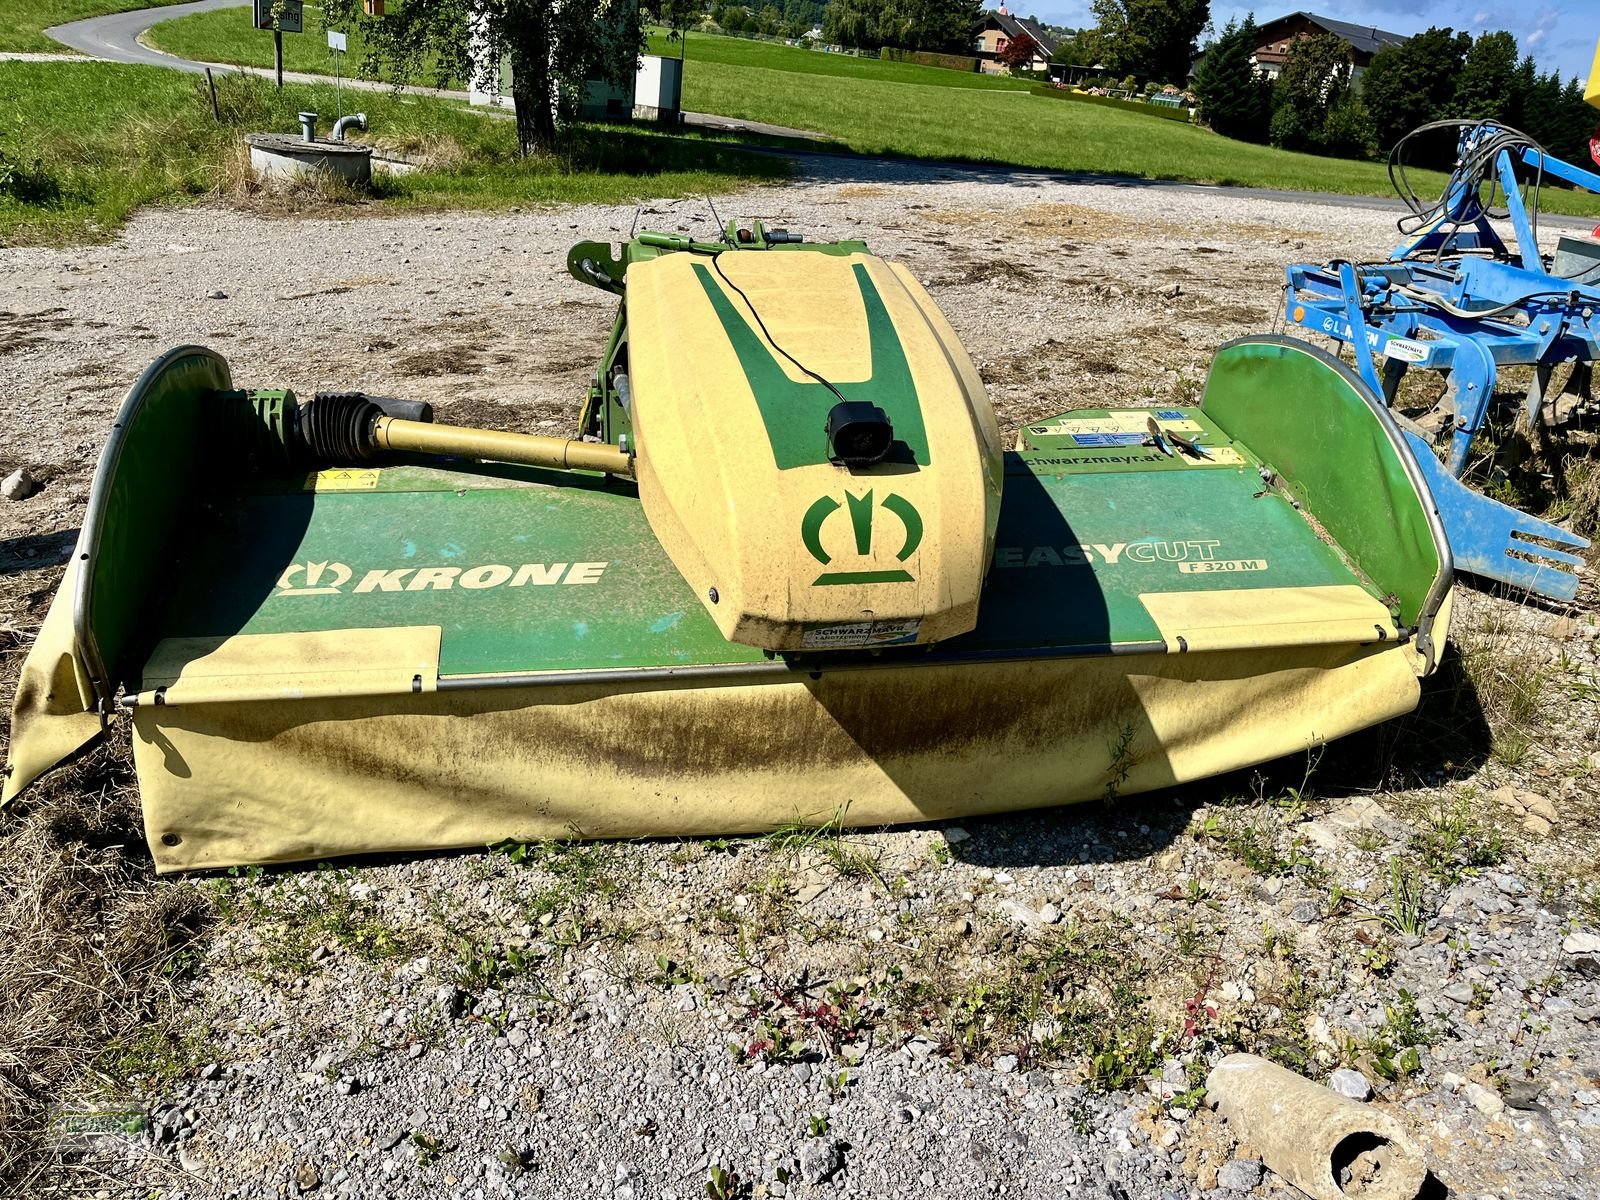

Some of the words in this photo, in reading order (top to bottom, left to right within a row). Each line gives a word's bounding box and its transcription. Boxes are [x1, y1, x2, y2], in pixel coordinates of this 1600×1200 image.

[262, 6, 299, 24] Psing
[1390, 341, 1423, 354] SCHWARZMAYR
[995, 540, 1220, 568] EASYCUT
[1189, 563, 1198, 572] F
[1205, 562, 1236, 572] 320
[1241, 560, 1259, 570] M
[352, 561, 609, 593] KRONE
[815, 625, 905, 636] SCHWARZMAYR
